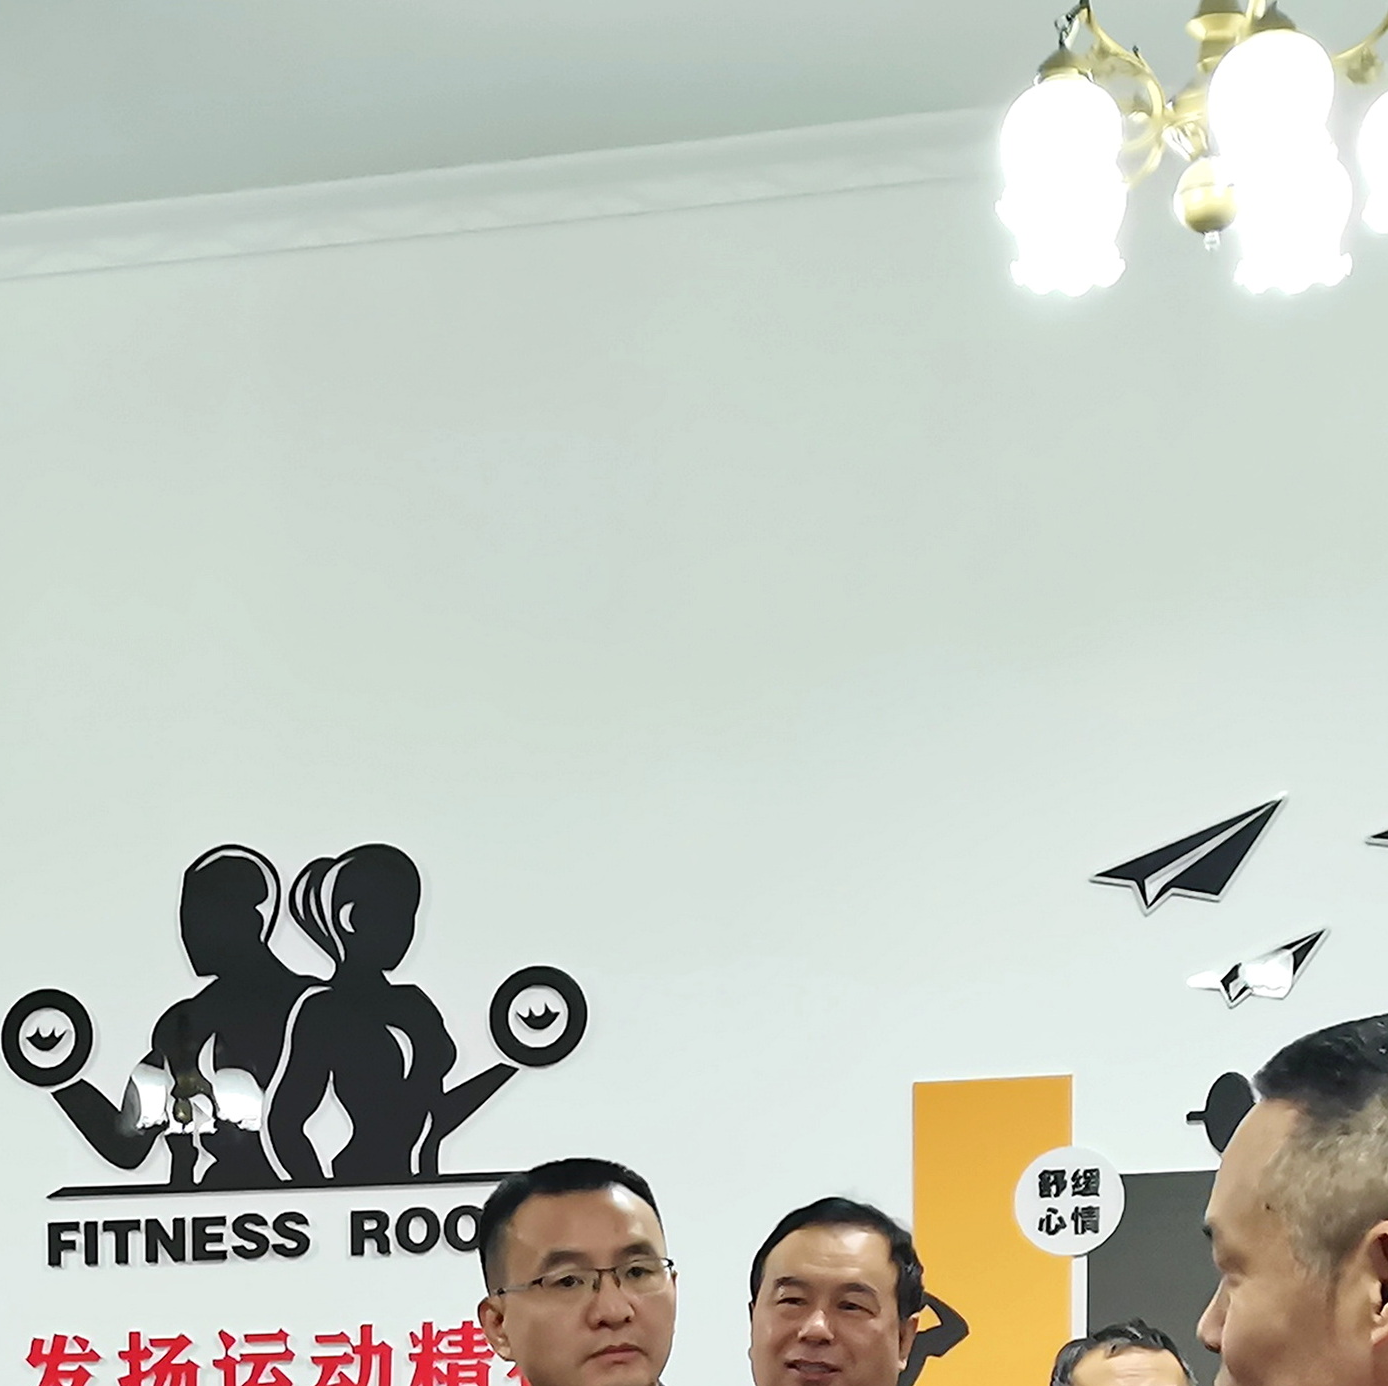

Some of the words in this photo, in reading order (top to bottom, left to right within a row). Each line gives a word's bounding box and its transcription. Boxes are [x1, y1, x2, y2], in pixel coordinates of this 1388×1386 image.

[1038, 1168, 1100, 1198] 舒缓
[47, 1211, 311, 1267] FITNESS
[349, 1205, 481, 1257] ROO
[1038, 1206, 1100, 1236] 心情
